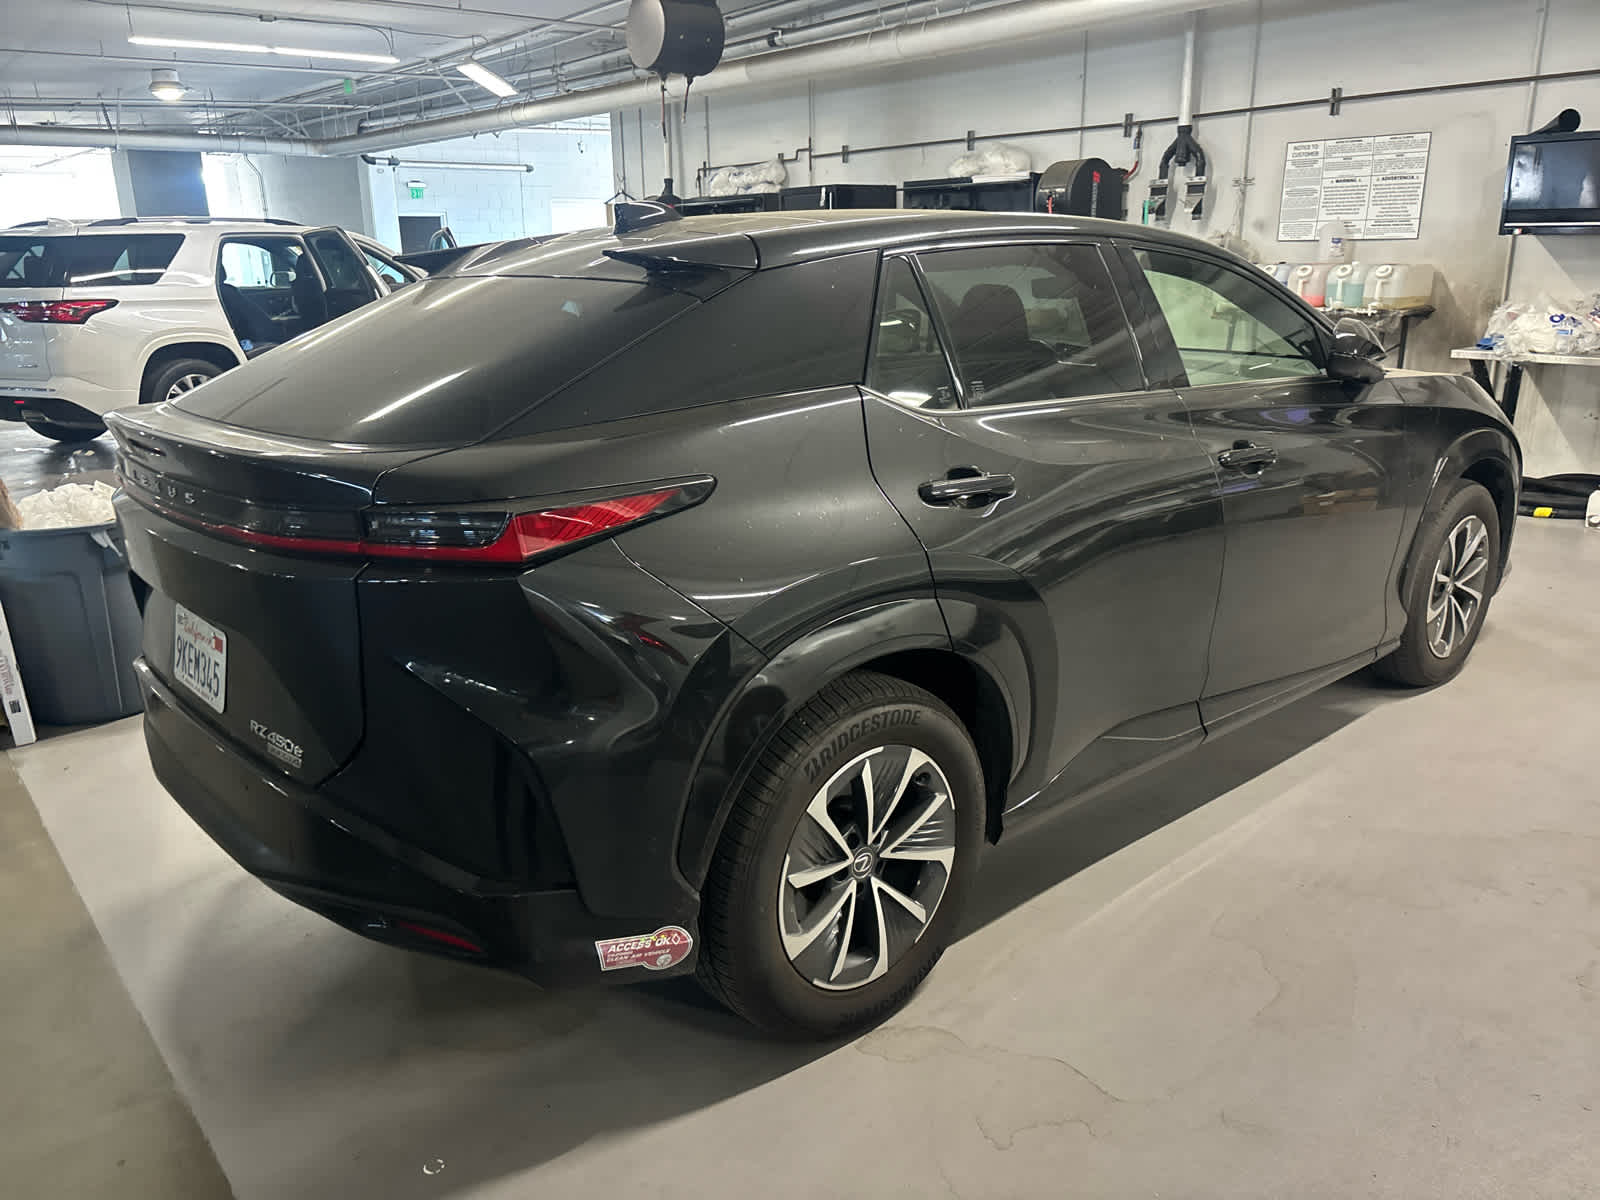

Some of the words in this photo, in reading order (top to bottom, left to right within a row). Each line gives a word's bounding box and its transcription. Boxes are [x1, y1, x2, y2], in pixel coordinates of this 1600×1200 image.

[176, 635, 220, 697] 9KEM345
[803, 709, 921, 784] BRIDGESTONE
[607, 940, 651, 953] ACCESS
[655, 936, 671, 947] OK
